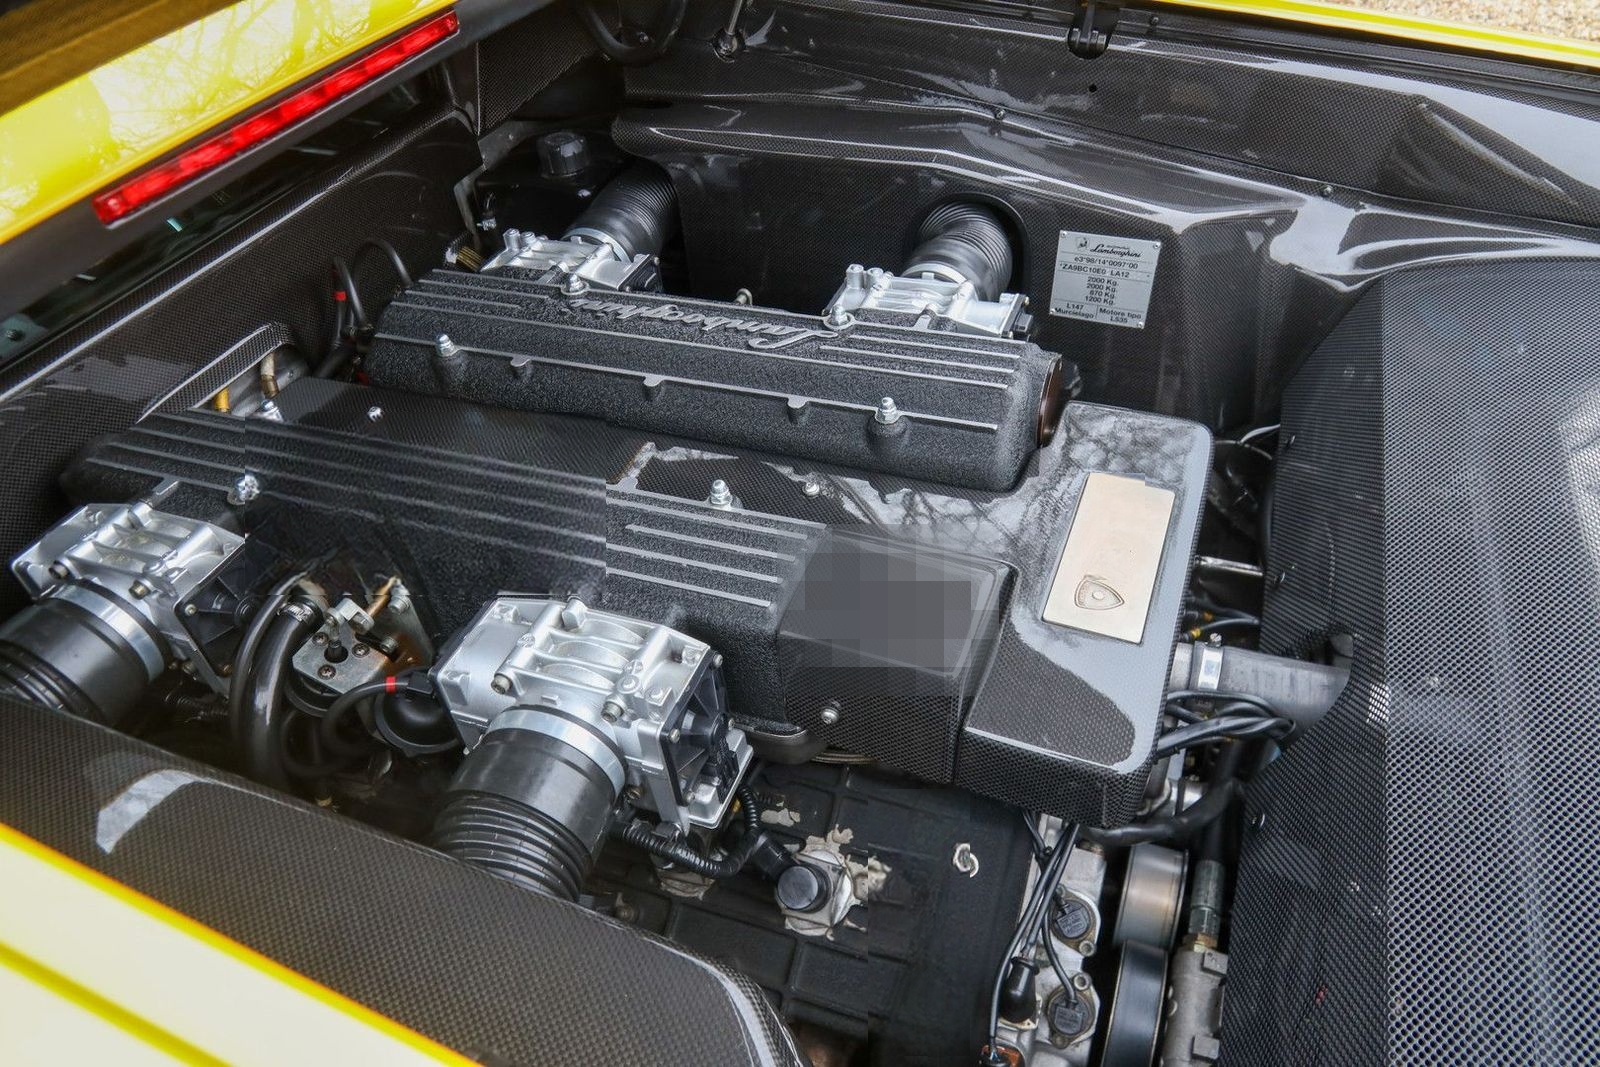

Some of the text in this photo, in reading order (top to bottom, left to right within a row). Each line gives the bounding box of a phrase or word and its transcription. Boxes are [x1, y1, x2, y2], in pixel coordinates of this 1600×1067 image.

[1090, 244, 1142, 258] Lamborghini
[1110, 269, 1130, 278] LA12
[1087, 276, 1105, 284] 2000
[1099, 307, 1125, 317] Motore
[561, 298, 839, 350] Lamborghini
